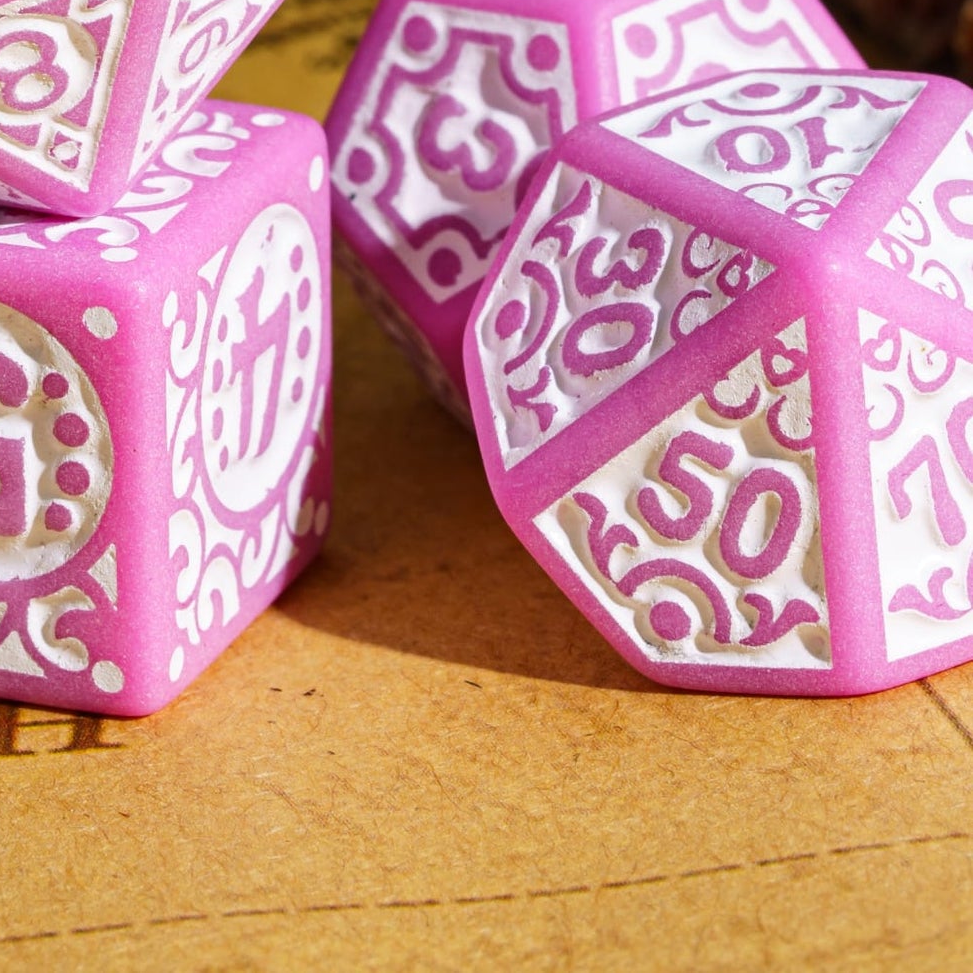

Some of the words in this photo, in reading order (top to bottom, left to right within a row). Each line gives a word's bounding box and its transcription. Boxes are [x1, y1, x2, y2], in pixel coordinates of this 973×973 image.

[417, 93, 517, 192] 3
[715, 116, 844, 174] 10
[229, 265, 291, 461] 4
[563, 227, 668, 377] 30
[637, 430, 802, 580] 50
